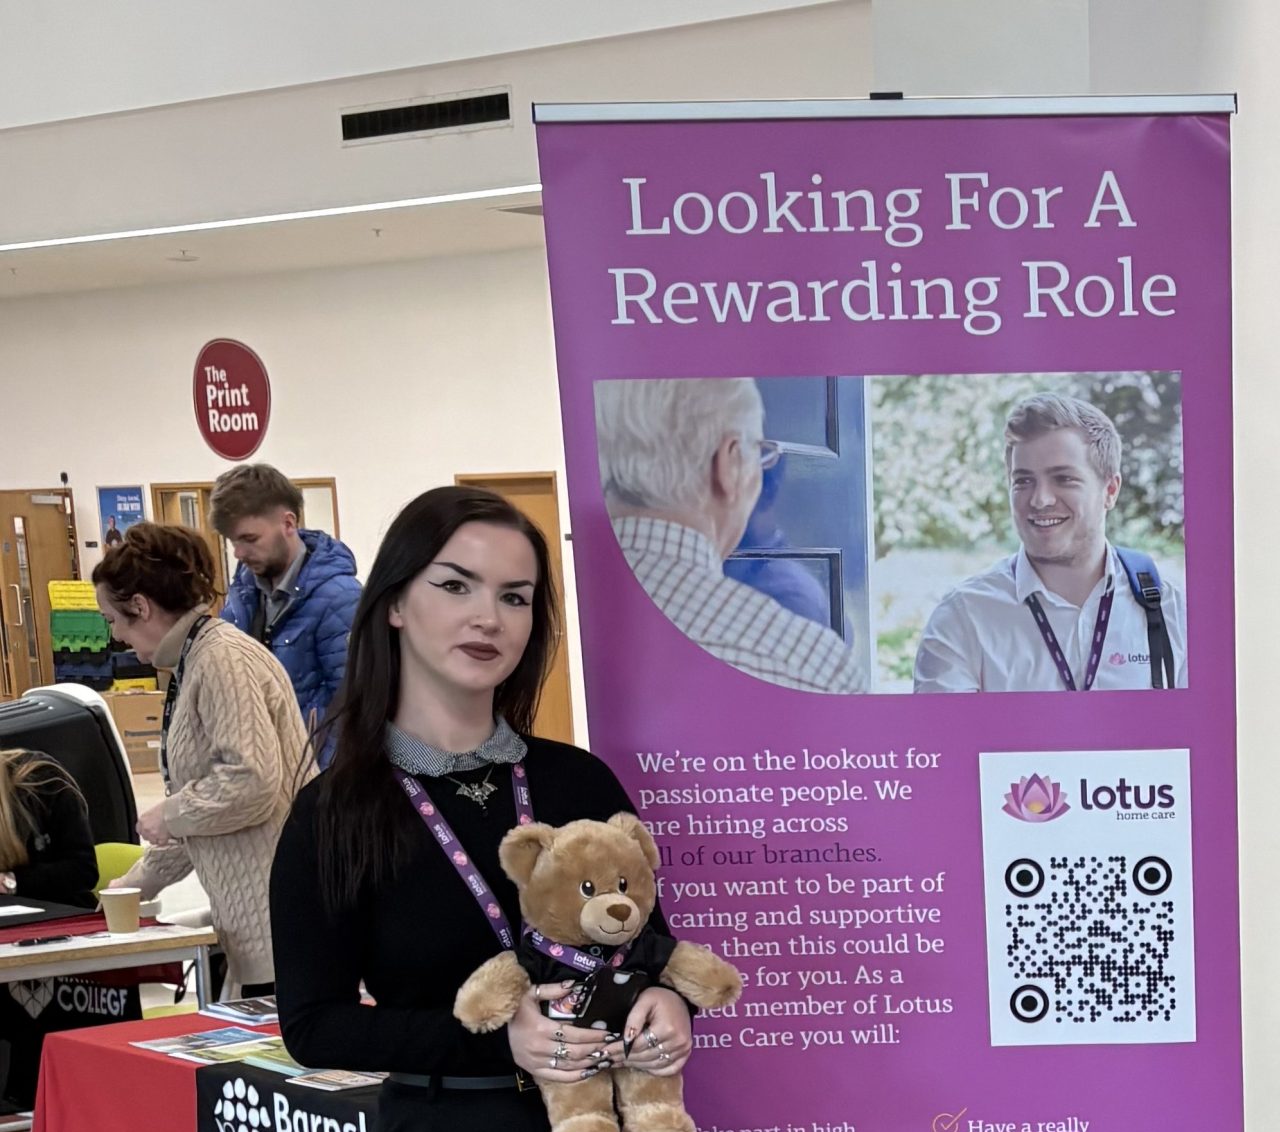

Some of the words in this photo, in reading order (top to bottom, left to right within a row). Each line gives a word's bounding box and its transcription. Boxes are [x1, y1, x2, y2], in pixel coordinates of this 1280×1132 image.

[622, 172, 923, 247] Looking
[945, 173, 1063, 230] For
[1084, 171, 1136, 228] A
[608, 260, 1002, 335] Rewarding
[1022, 256, 1177, 318] Role
[204, 365, 227, 382] The
[206, 382, 250, 408] Print
[208, 409, 259, 432] Room
[636, 750, 706, 774] We're
[713, 755, 745, 771] on
[754, 750, 795, 771] the
[803, 749, 898, 769] lookout
[906, 748, 941, 768] for
[639, 784, 774, 809] passionate
[781, 781, 868, 806] people.
[874, 780, 912, 800] We
[1080, 778, 1175, 810] lotus
[643, 819, 680, 836] are
[688, 814, 765, 838] hiring
[772, 816, 848, 834] across
[1116, 810, 1150, 821] home
[1151, 811, 1176, 821] care
[658, 845, 674, 867] ll
[681, 845, 705, 866] of
[713, 850, 755, 866] our
[764, 843, 882, 865] branches.
[656, 877, 666, 898] f
[672, 881, 716, 902] you
[724, 878, 788, 896] want
[795, 876, 821, 895] to
[826, 874, 855, 894] be
[863, 875, 914, 897] part
[921, 872, 945, 893] of
[669, 910, 748, 932] caring
[755, 906, 802, 926] and
[809, 904, 941, 926] supportive
[722, 938, 781, 957] then
[789, 936, 837, 955] this
[843, 935, 909, 954] could
[917, 934, 945, 953] be
[756, 967, 790, 986] for
[798, 970, 847, 991] you.
[854, 966, 883, 985] As
[890, 970, 904, 985] a
[744, 996, 846, 1017] member
[853, 995, 877, 1015] of
[884, 996, 953, 1015] Lotus
[694, 1032, 732, 1049] me
[739, 1028, 793, 1047] Care
[800, 1030, 844, 1050] you
[850, 1024, 900, 1044] will:
